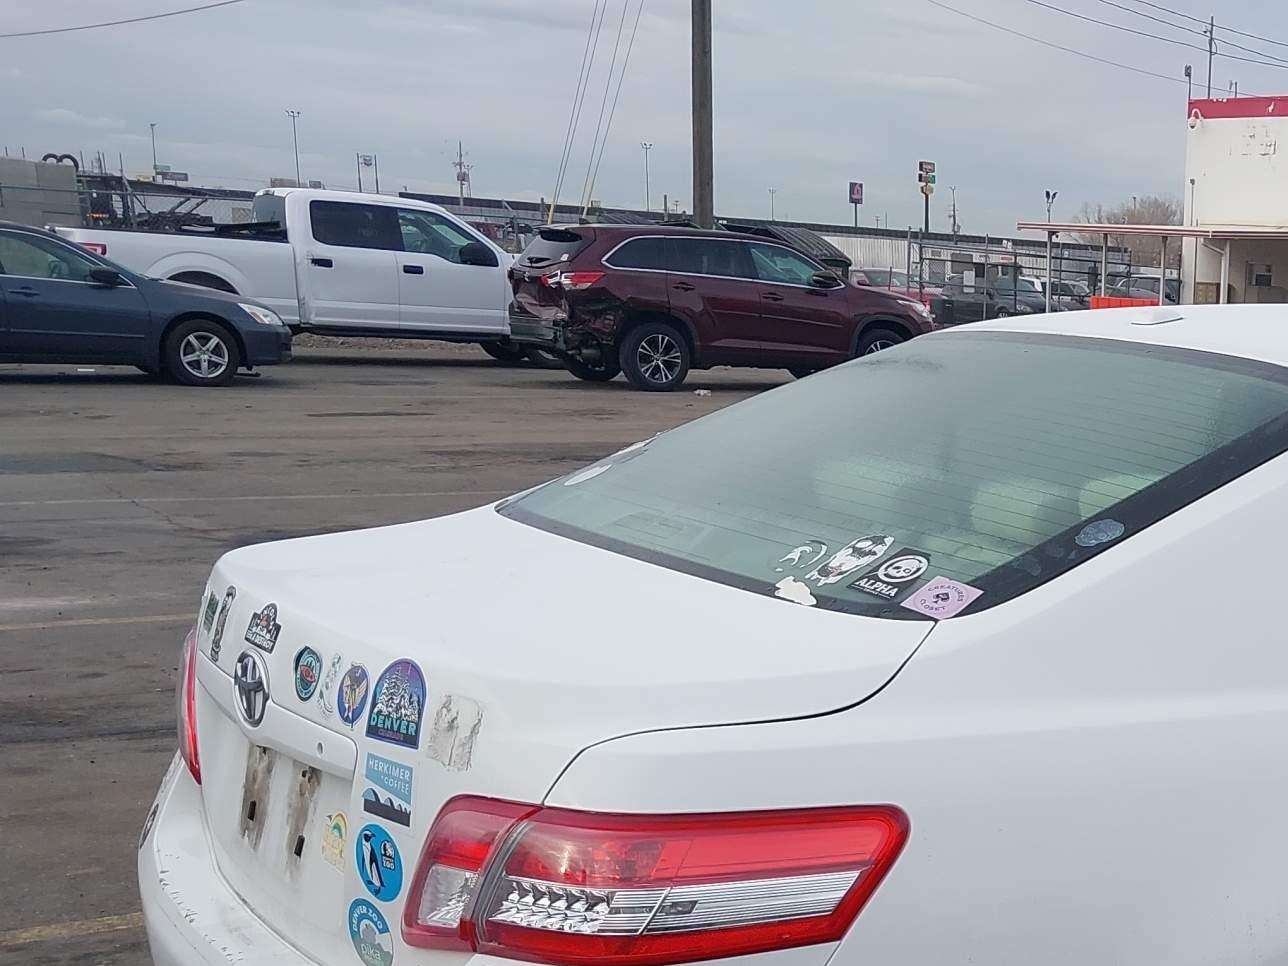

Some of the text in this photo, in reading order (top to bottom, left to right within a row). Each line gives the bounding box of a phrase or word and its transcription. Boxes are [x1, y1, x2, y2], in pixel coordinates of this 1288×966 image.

[854, 578, 899, 597] ALPHA
[370, 714, 417, 736] DENVER
[368, 757, 410, 781] HERKIMER
[352, 905, 384, 932] DENVER ZOO
[361, 944, 382, 961] pika
